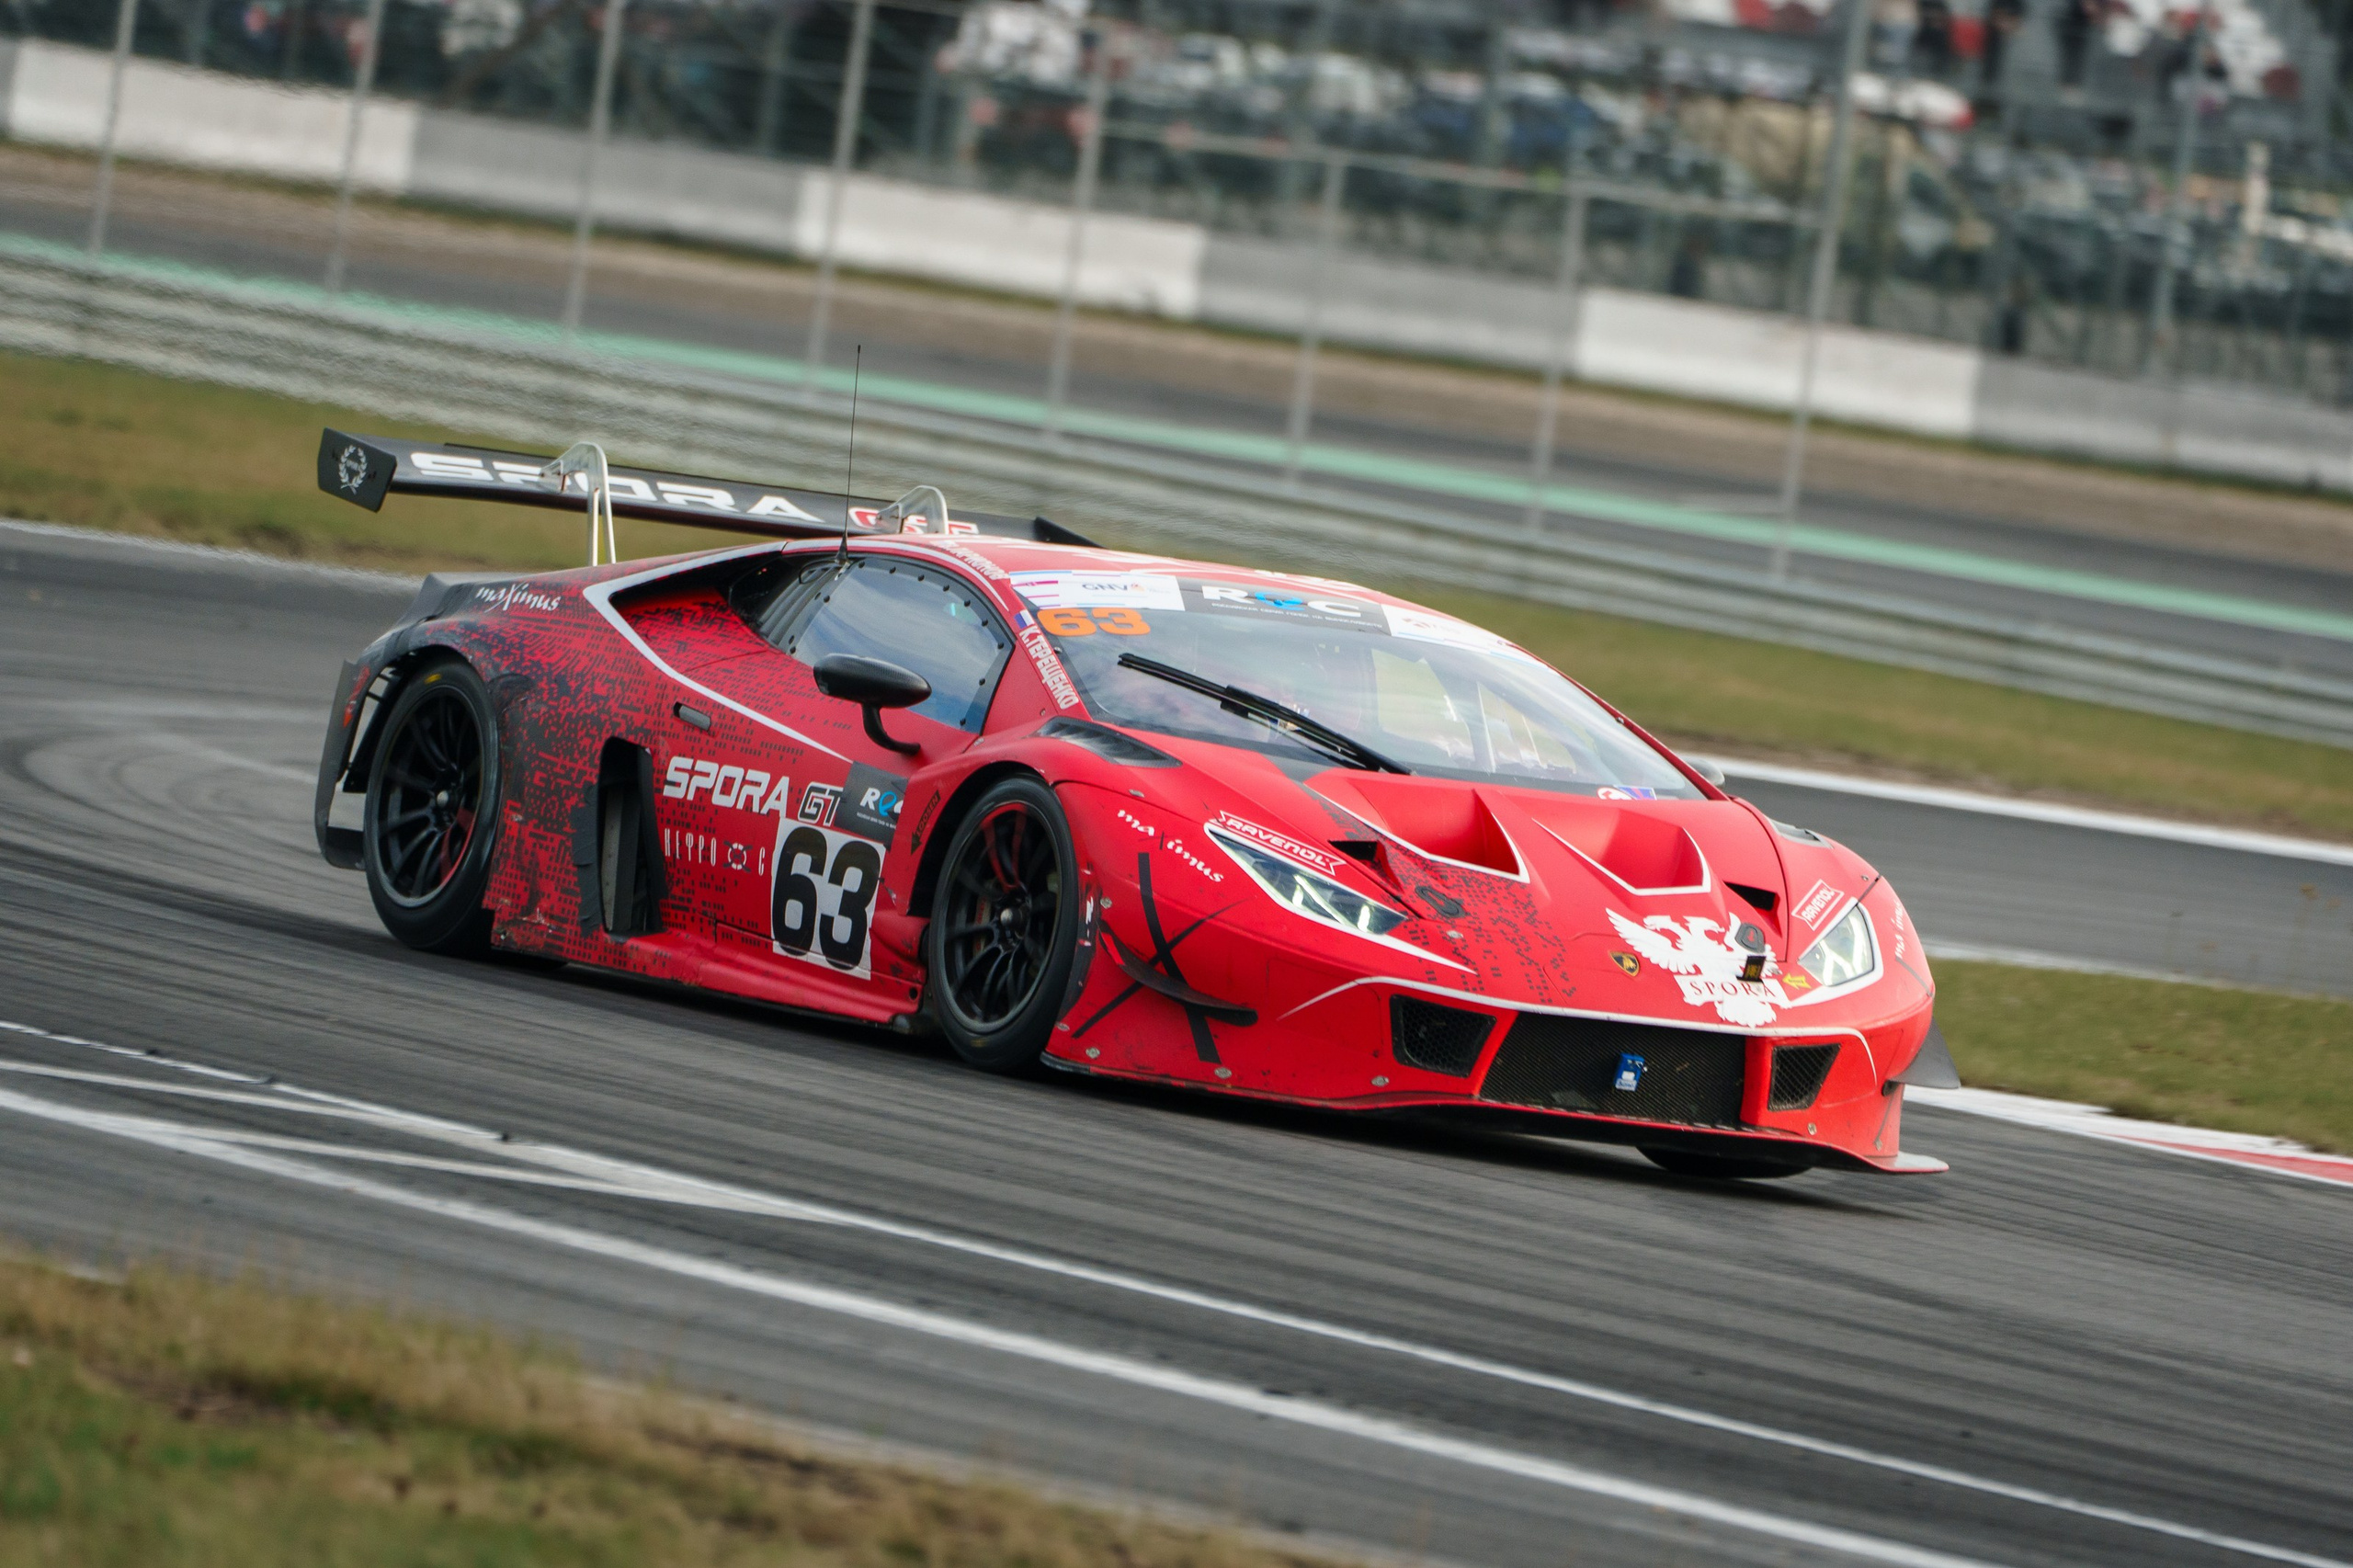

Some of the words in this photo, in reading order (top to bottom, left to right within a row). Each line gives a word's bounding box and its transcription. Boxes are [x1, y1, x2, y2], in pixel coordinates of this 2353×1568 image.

[410, 452, 825, 523] SPORA
[1037, 608, 1151, 636] 63
[1018, 625, 1079, 710] К.ТЕРЕЩЕНКО
[663, 756, 790, 817] SPORA
[797, 781, 845, 826] GT
[1226, 819, 1328, 867] RAVENOL
[772, 826, 881, 970] 63
[1801, 887, 1836, 923] RAVENOL
